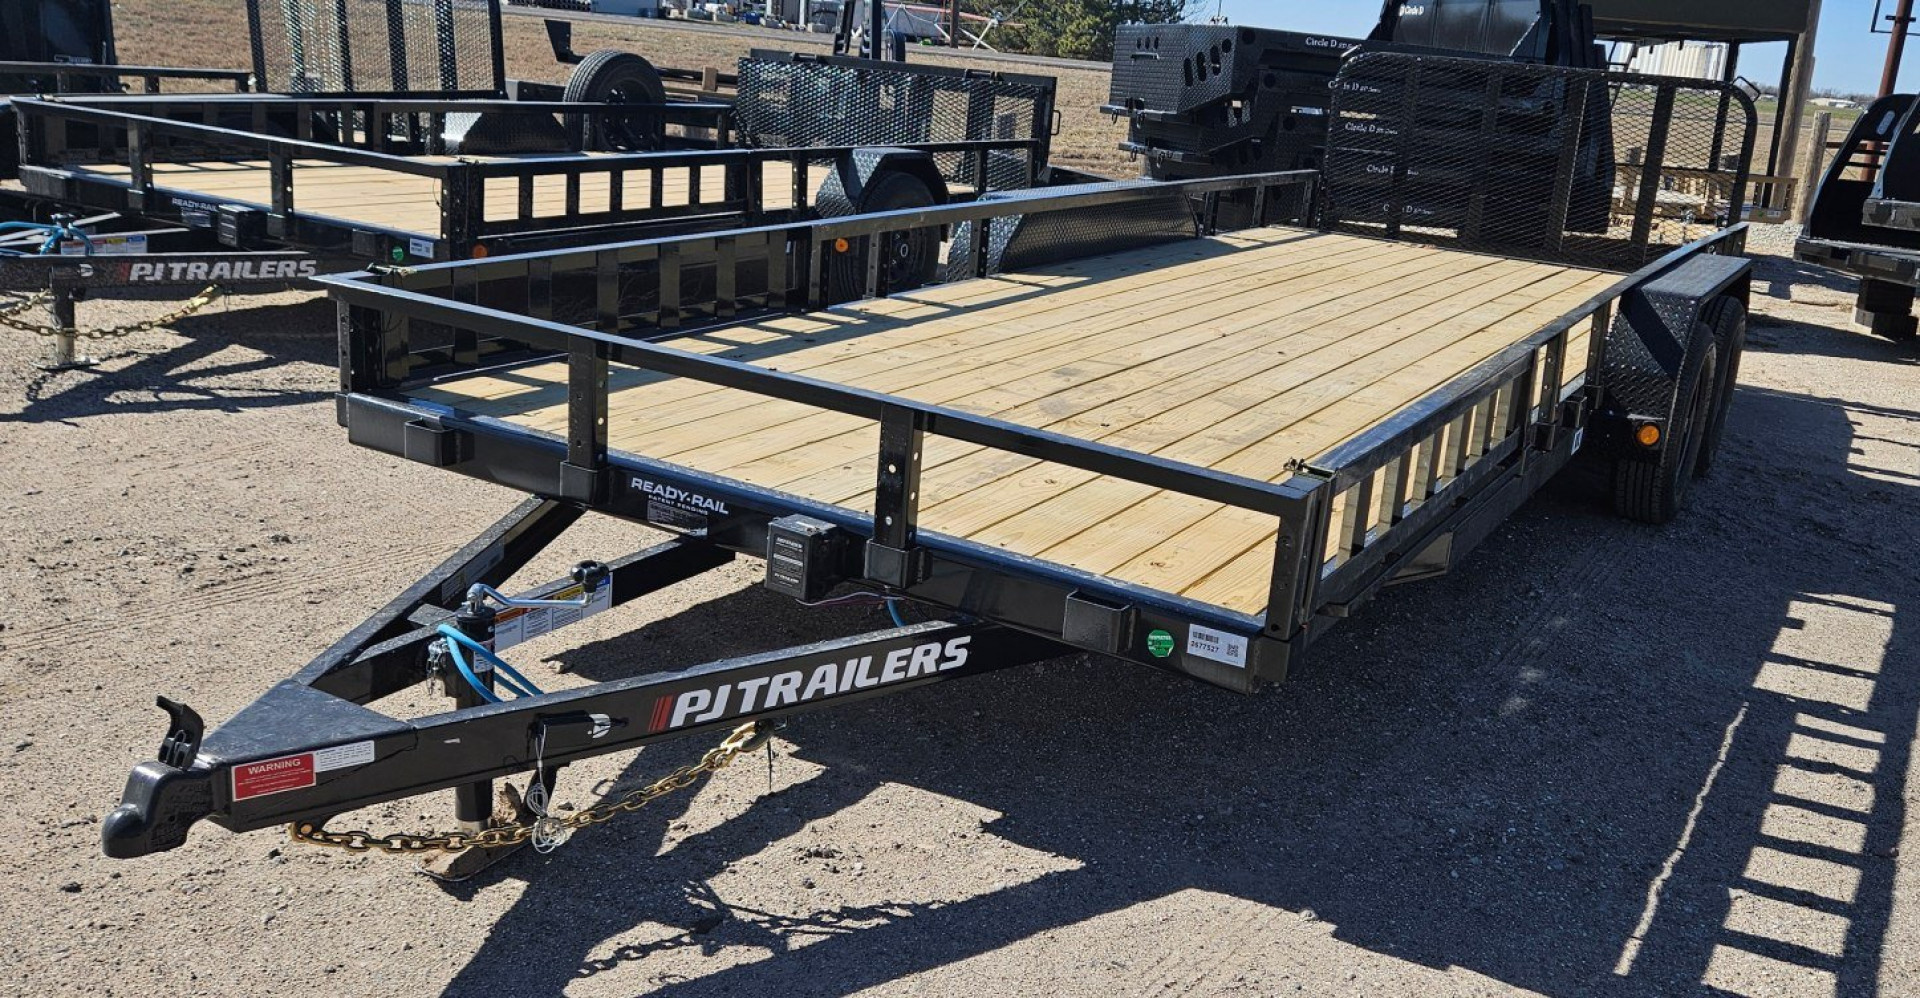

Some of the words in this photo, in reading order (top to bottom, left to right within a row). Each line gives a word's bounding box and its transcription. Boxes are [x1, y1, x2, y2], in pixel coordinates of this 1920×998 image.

[1305, 36, 1329, 47] Circle
[1330, 39, 1337, 47] D
[129, 263, 165, 281] PJ
[168, 259, 317, 281] TRAILERS
[669, 684, 732, 728] PJ
[737, 635, 972, 714] TRAILERS
[247, 758, 301, 775] WARNING
